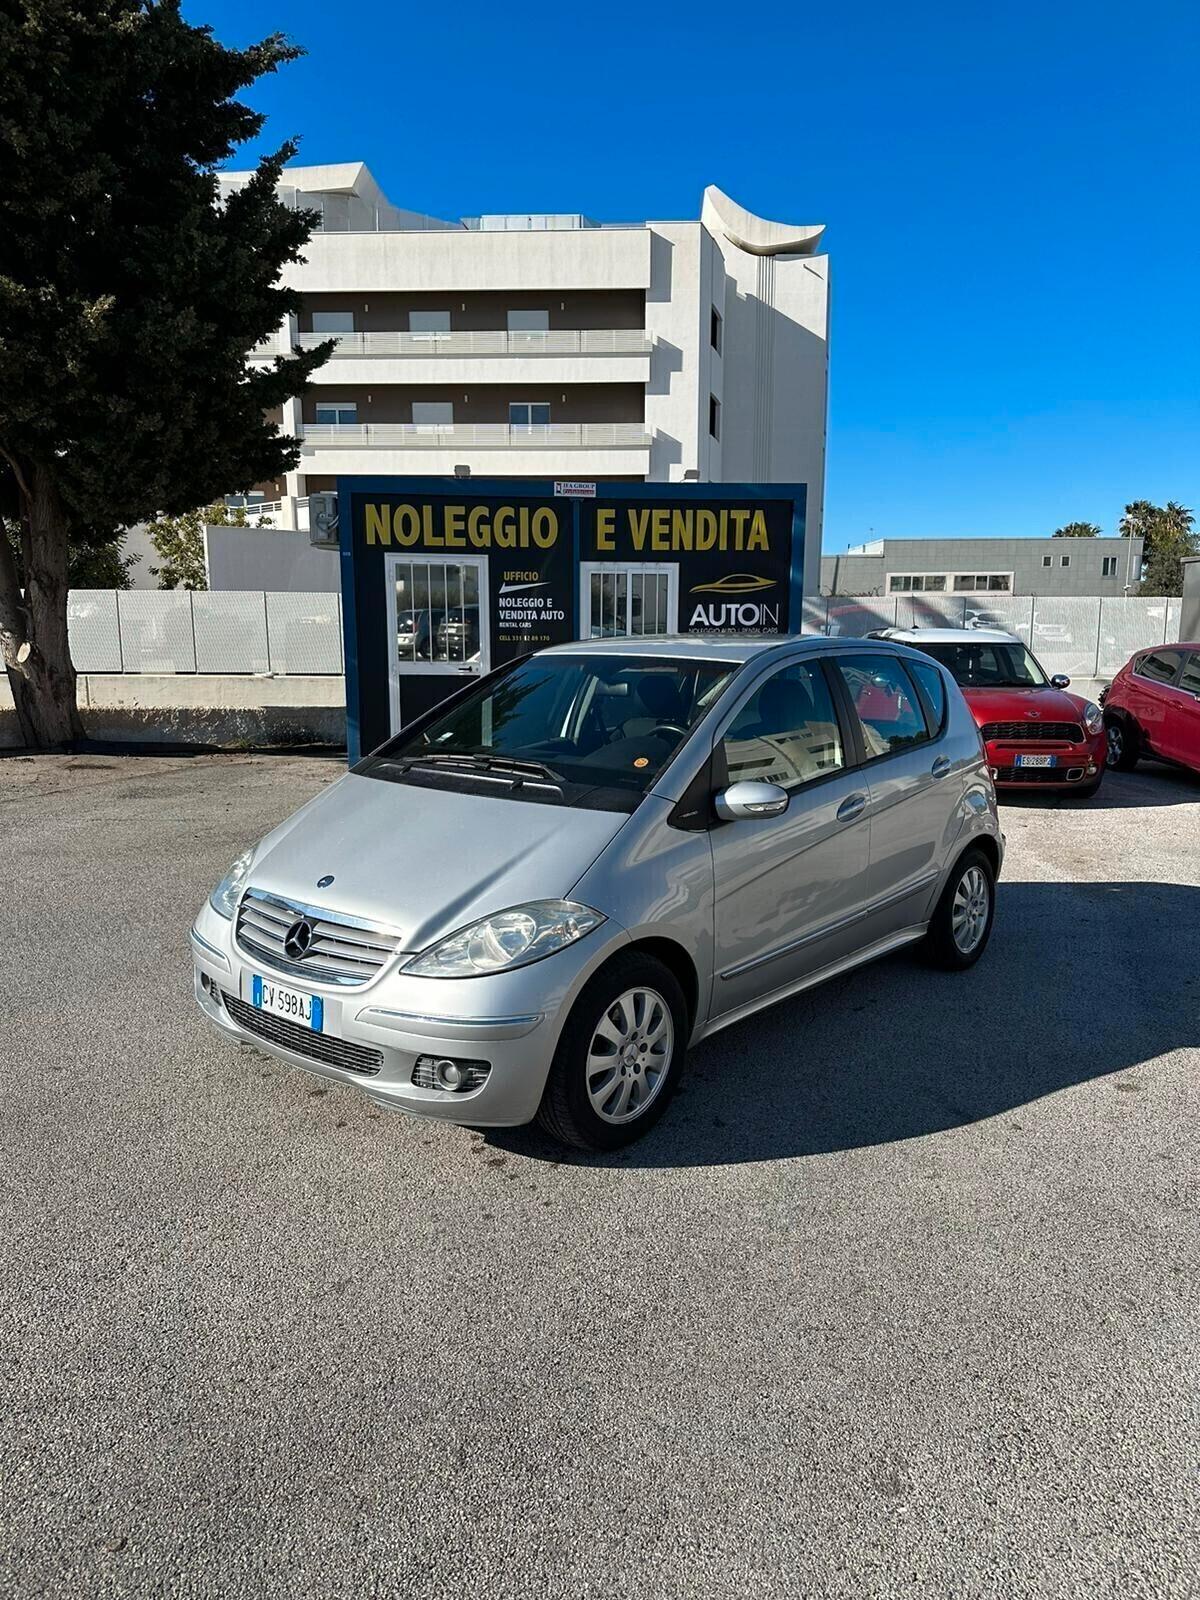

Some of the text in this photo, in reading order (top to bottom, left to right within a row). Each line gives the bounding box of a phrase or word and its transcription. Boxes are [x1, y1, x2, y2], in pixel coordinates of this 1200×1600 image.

[364, 503, 769, 551] NOLEGGIO E VENDITA
[503, 571, 539, 581] UFFICIO
[499, 597, 553, 608] NOLEGGIO E
[499, 610, 565, 620] VENDITA AUTO
[262, 984, 275, 1007] CV
[277, 990, 312, 1020] 598AJ
